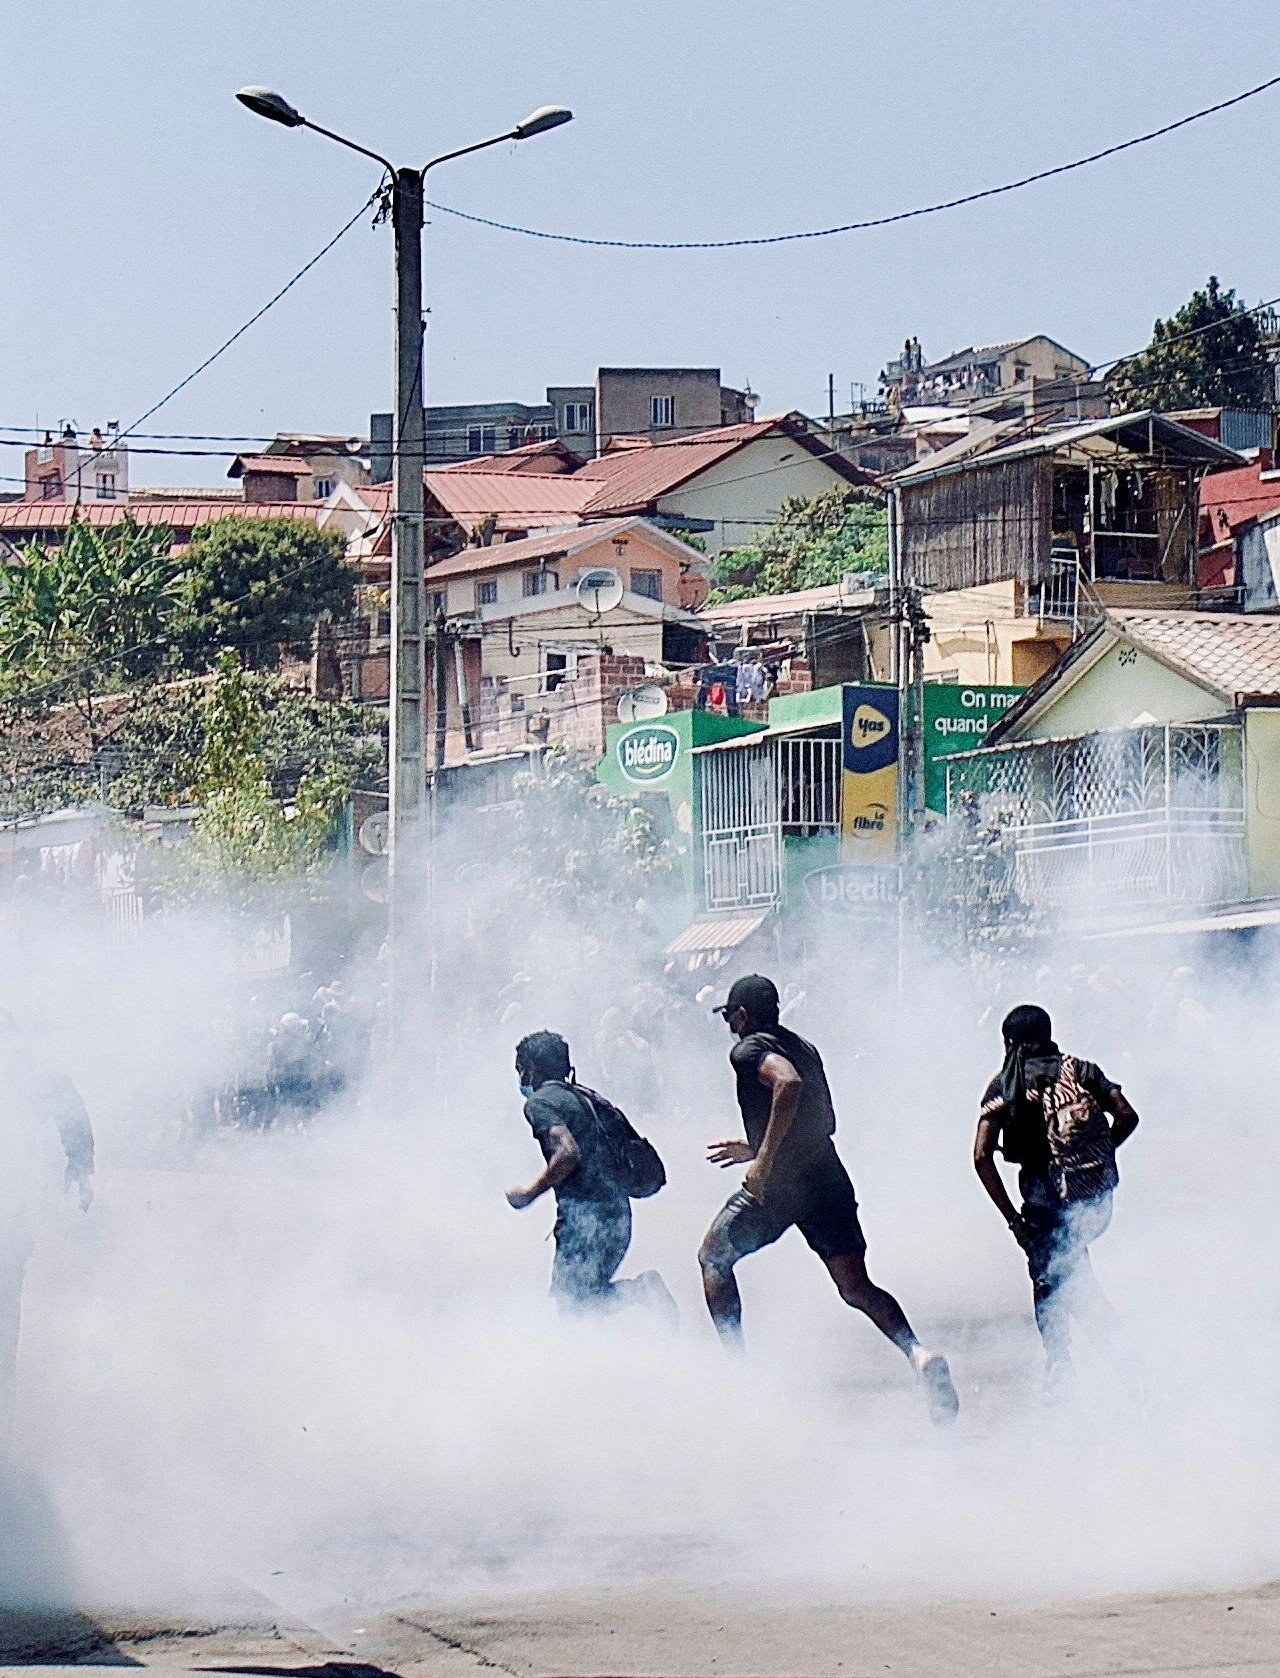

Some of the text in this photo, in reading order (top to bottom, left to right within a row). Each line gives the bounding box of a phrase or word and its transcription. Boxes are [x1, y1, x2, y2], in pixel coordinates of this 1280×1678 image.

[961, 689, 986, 708] On
[934, 714, 988, 736] quand
[625, 736, 673, 767] blédina
[853, 815, 884, 831] fibre
[820, 874, 899, 902] blédi
